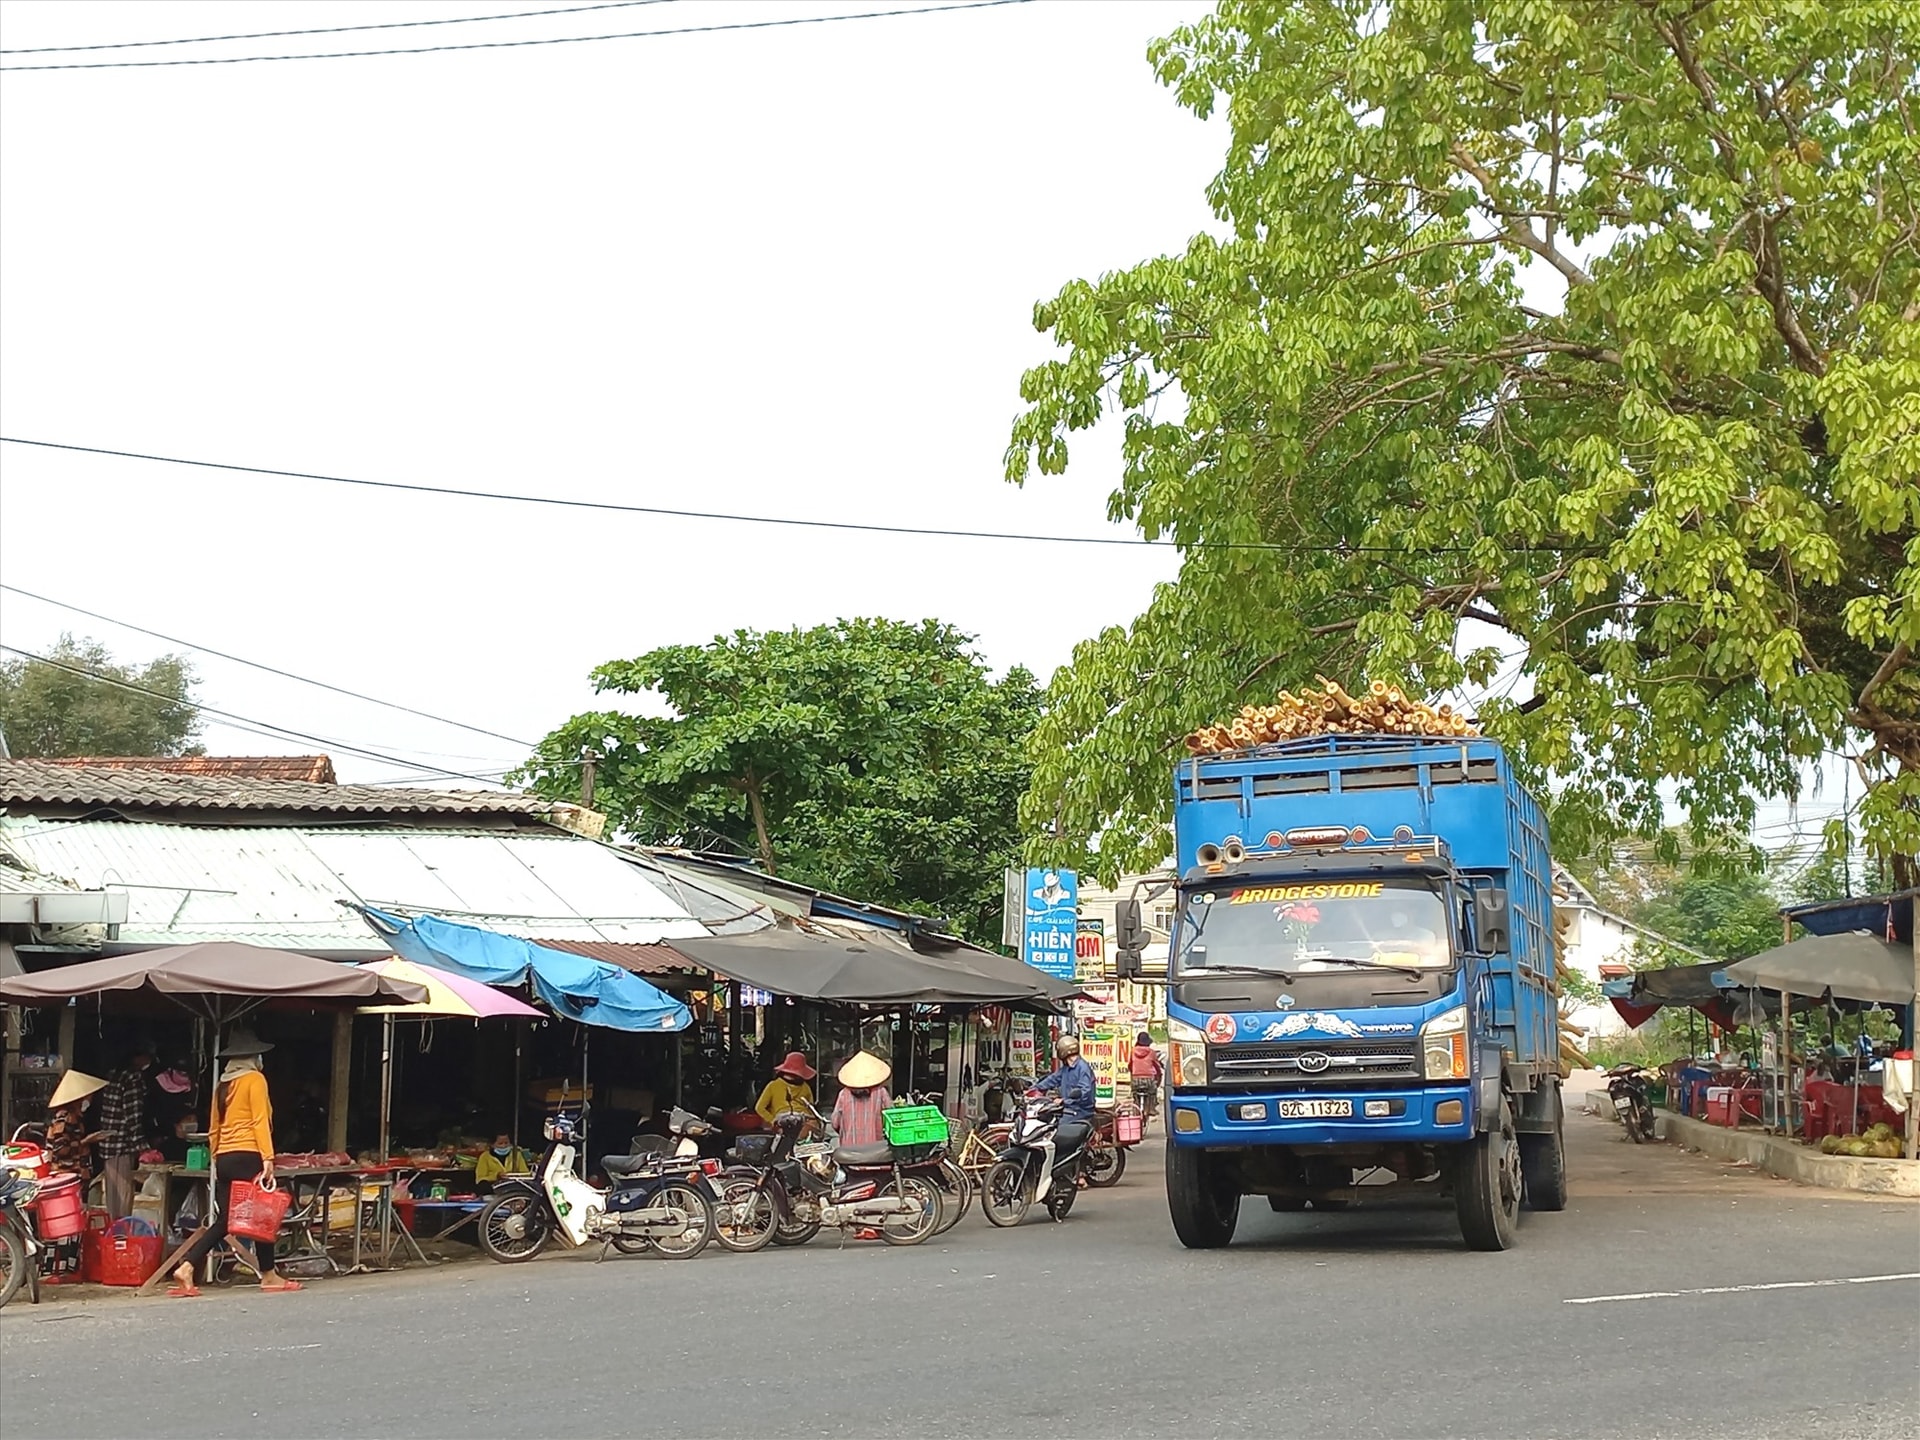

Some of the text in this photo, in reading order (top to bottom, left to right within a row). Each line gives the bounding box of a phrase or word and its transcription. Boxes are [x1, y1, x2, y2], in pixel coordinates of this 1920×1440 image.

[1230, 883, 1384, 905] BRIDGESTONE
[1028, 925, 1073, 949] HIỀN
[1076, 936, 1100, 957] ƠM
[1300, 1057, 1326, 1067] TMT
